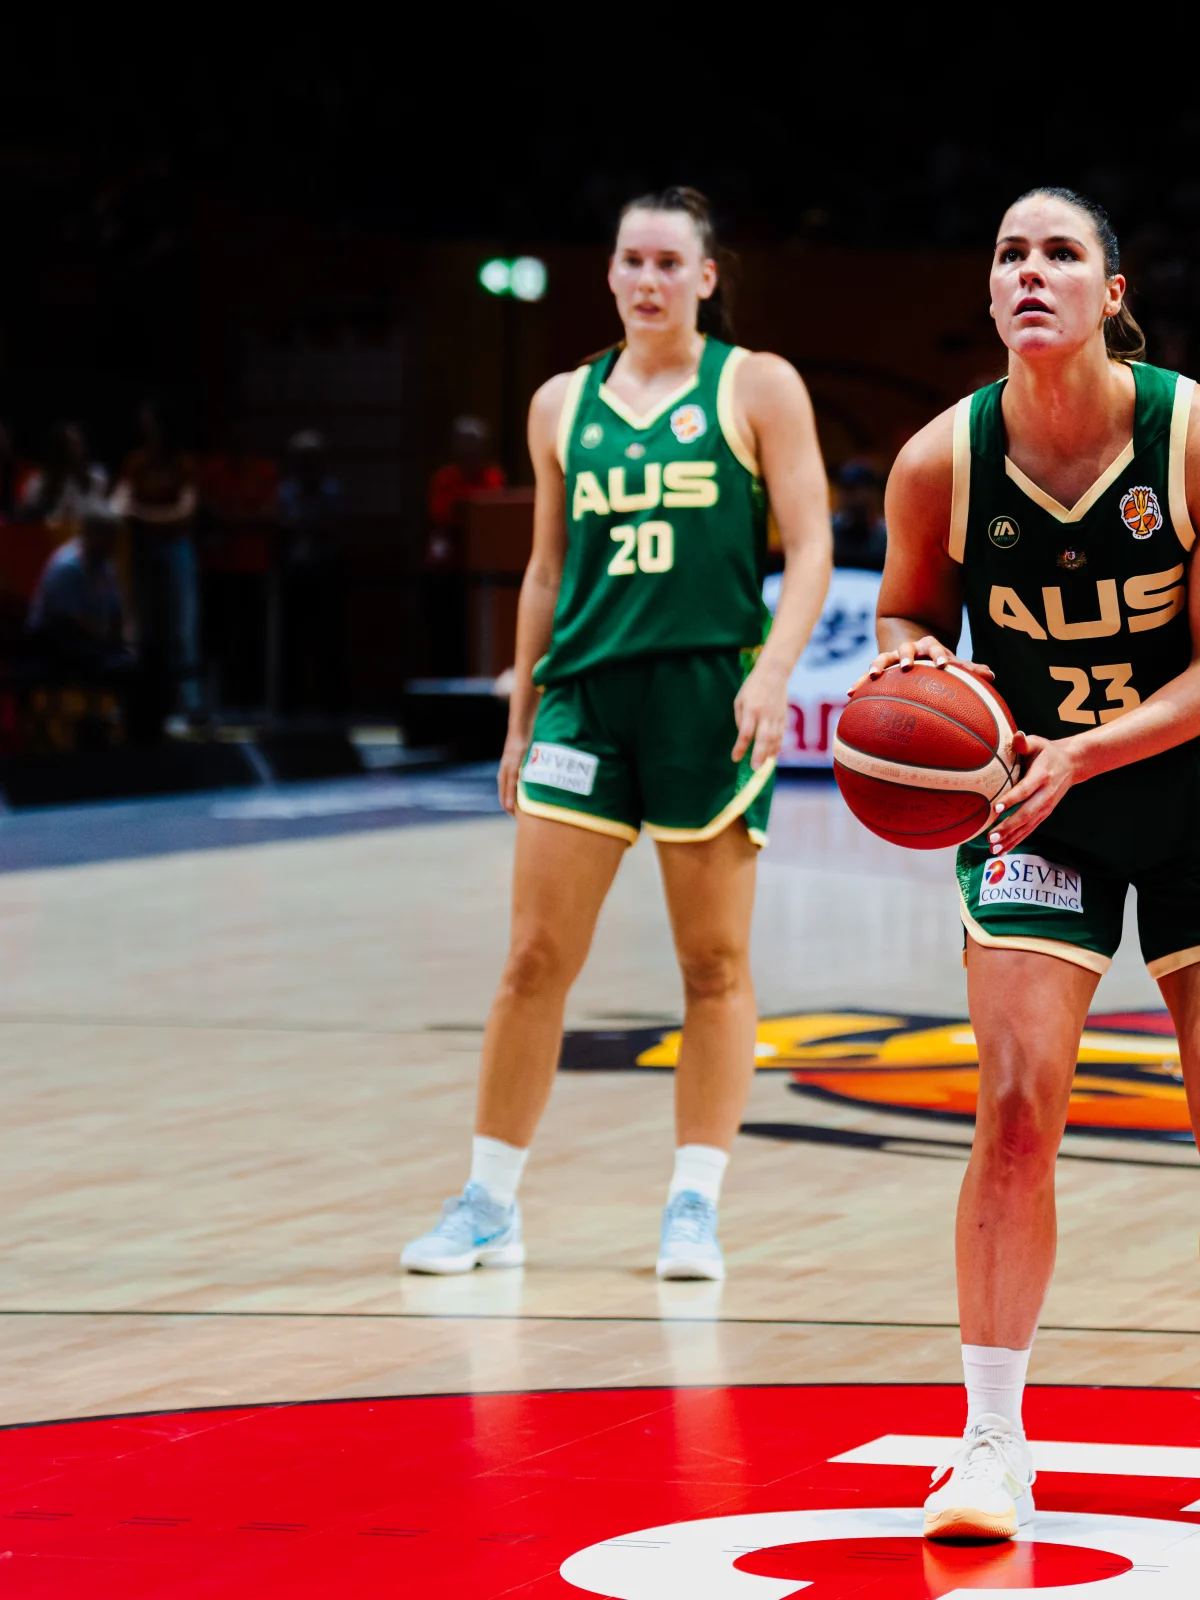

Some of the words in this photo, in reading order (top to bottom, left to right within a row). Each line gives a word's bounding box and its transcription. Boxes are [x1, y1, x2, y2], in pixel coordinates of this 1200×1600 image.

[572, 461, 719, 521] AUS
[607, 521, 674, 576] 20
[989, 562, 1186, 640] AUS
[876, 708, 917, 735] FIBA
[1049, 663, 1141, 725] 23
[981, 887, 1079, 910] CONSULTING
[1008, 860, 1078, 893] SEVEN
